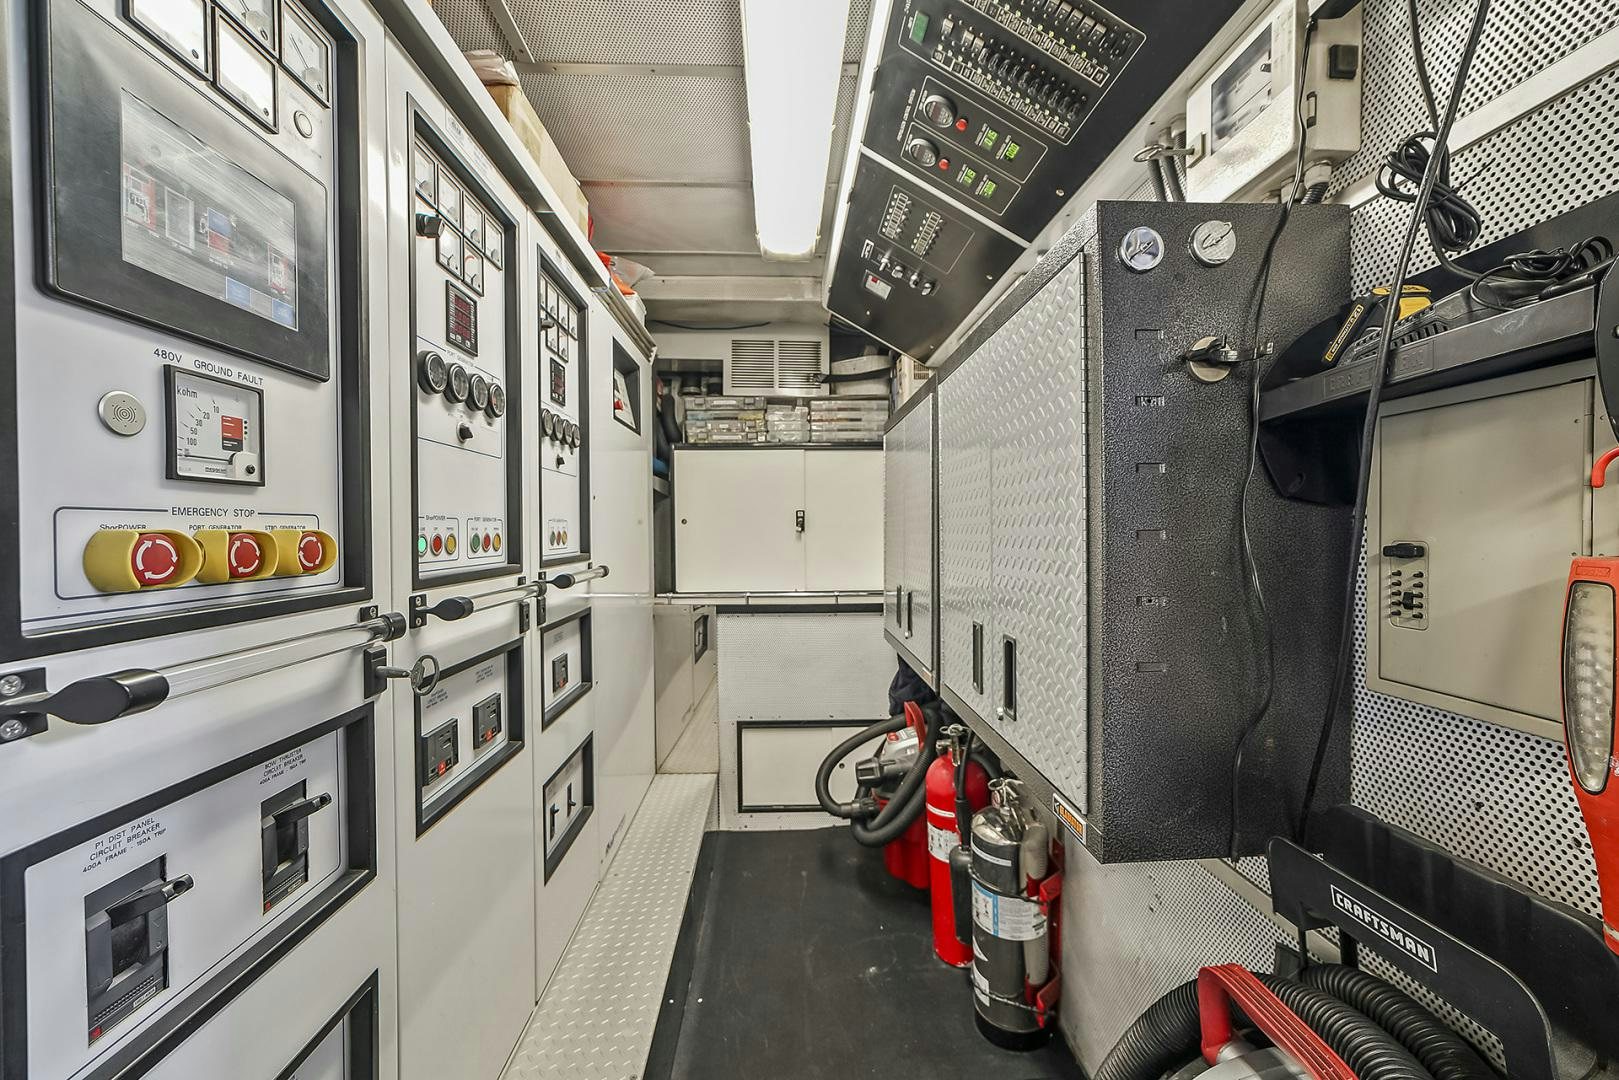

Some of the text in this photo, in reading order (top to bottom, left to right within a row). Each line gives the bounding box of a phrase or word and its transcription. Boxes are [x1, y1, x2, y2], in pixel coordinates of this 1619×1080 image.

[153, 348, 263, 386] 480V GROUND FAULT
[176, 385, 198, 399] kohm
[202, 411, 210, 420] 20
[213, 405, 220, 414] 10
[195, 418, 203, 427] 30
[190, 427, 198, 436] 50
[186, 437, 198, 447] 100
[171, 506, 255, 518] EMERGENCY STOP
[95, 817, 155, 850] P1 DIST PANEL
[89, 822, 160, 861] CIRCUIT BREAKER
[82, 860, 102, 873] 400A
[105, 847, 128, 862] FRAME
[1335, 892, 1430, 963] CRAFTSMAN
